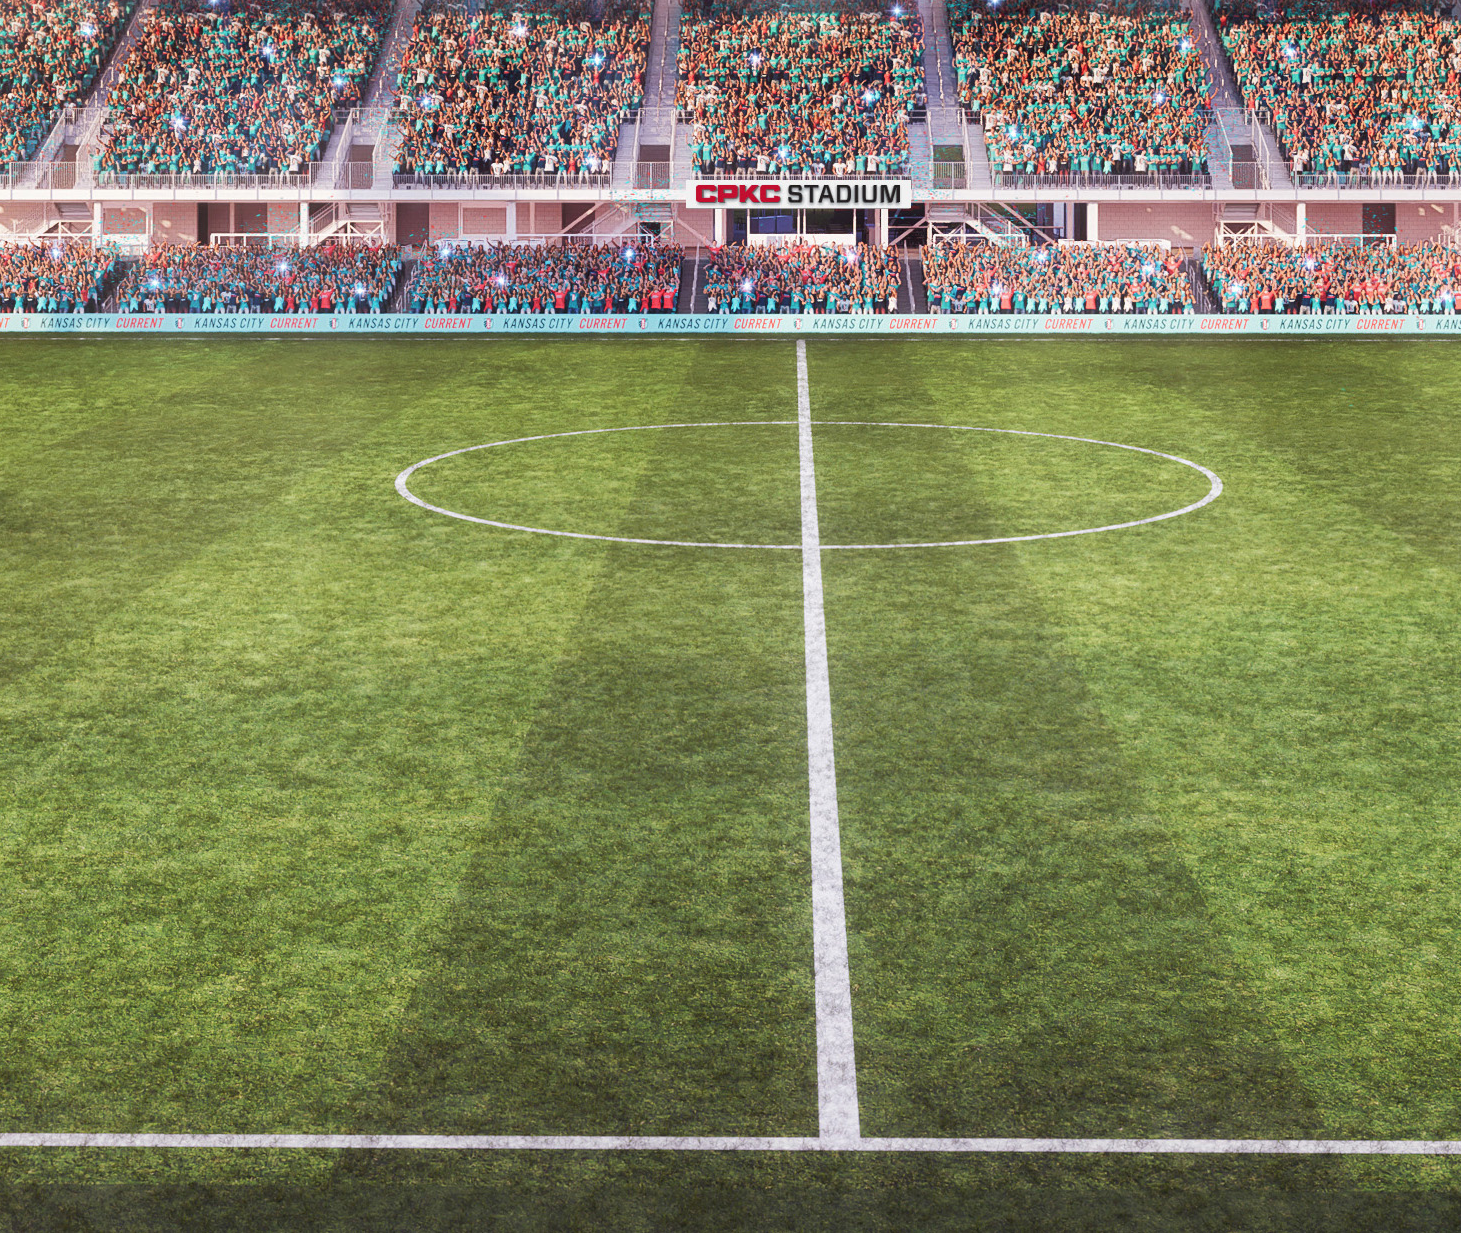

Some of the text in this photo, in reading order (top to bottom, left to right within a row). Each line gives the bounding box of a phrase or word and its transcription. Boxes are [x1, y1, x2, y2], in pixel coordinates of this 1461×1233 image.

[696, 184, 901, 204] CPKC STADIUM
[41, 317, 165, 329] KANSAS CITY CURRENT
[195, 317, 319, 329] KANSAS CITY CURRENT
[350, 317, 474, 329] KANSAS CITY CURRENT
[504, 318, 628, 329] KANSAS CITY CURRENT
[660, 318, 784, 329] KANSAS CITY CURRENT
[814, 318, 938, 329] KANSAS CITY CURRENT
[970, 318, 1094, 330] KANSAS CITY CURRENT
[1125, 318, 1250, 330] KANSAS CITY CURRENT
[1280, 318, 1405, 330] KANSAS CITY CURRENT
